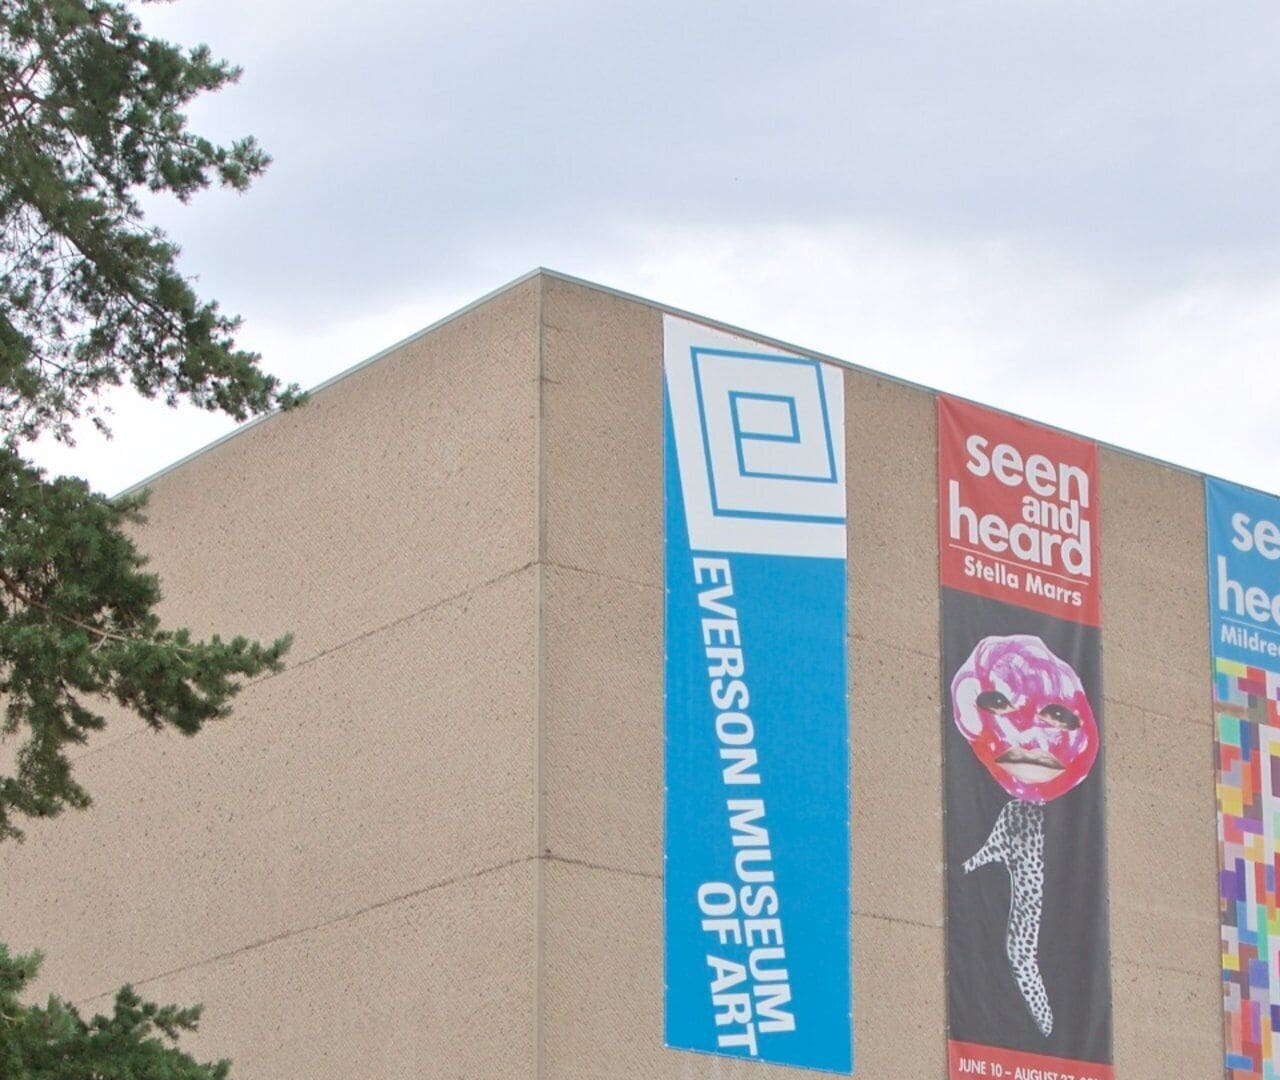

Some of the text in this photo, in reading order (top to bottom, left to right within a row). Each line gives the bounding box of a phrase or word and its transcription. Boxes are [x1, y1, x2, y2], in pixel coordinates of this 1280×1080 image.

[966, 434, 1089, 508] seen
[949, 479, 1092, 578] heard
[1022, 495, 1079, 537] and
[964, 555, 1082, 606] Stella Marrs
[693, 556, 796, 1034] EVERSON MUSEUM
[697, 881, 758, 1057] OF ART
[958, 1058, 986, 1075] JUNE
[990, 1062, 1002, 1078] 10
